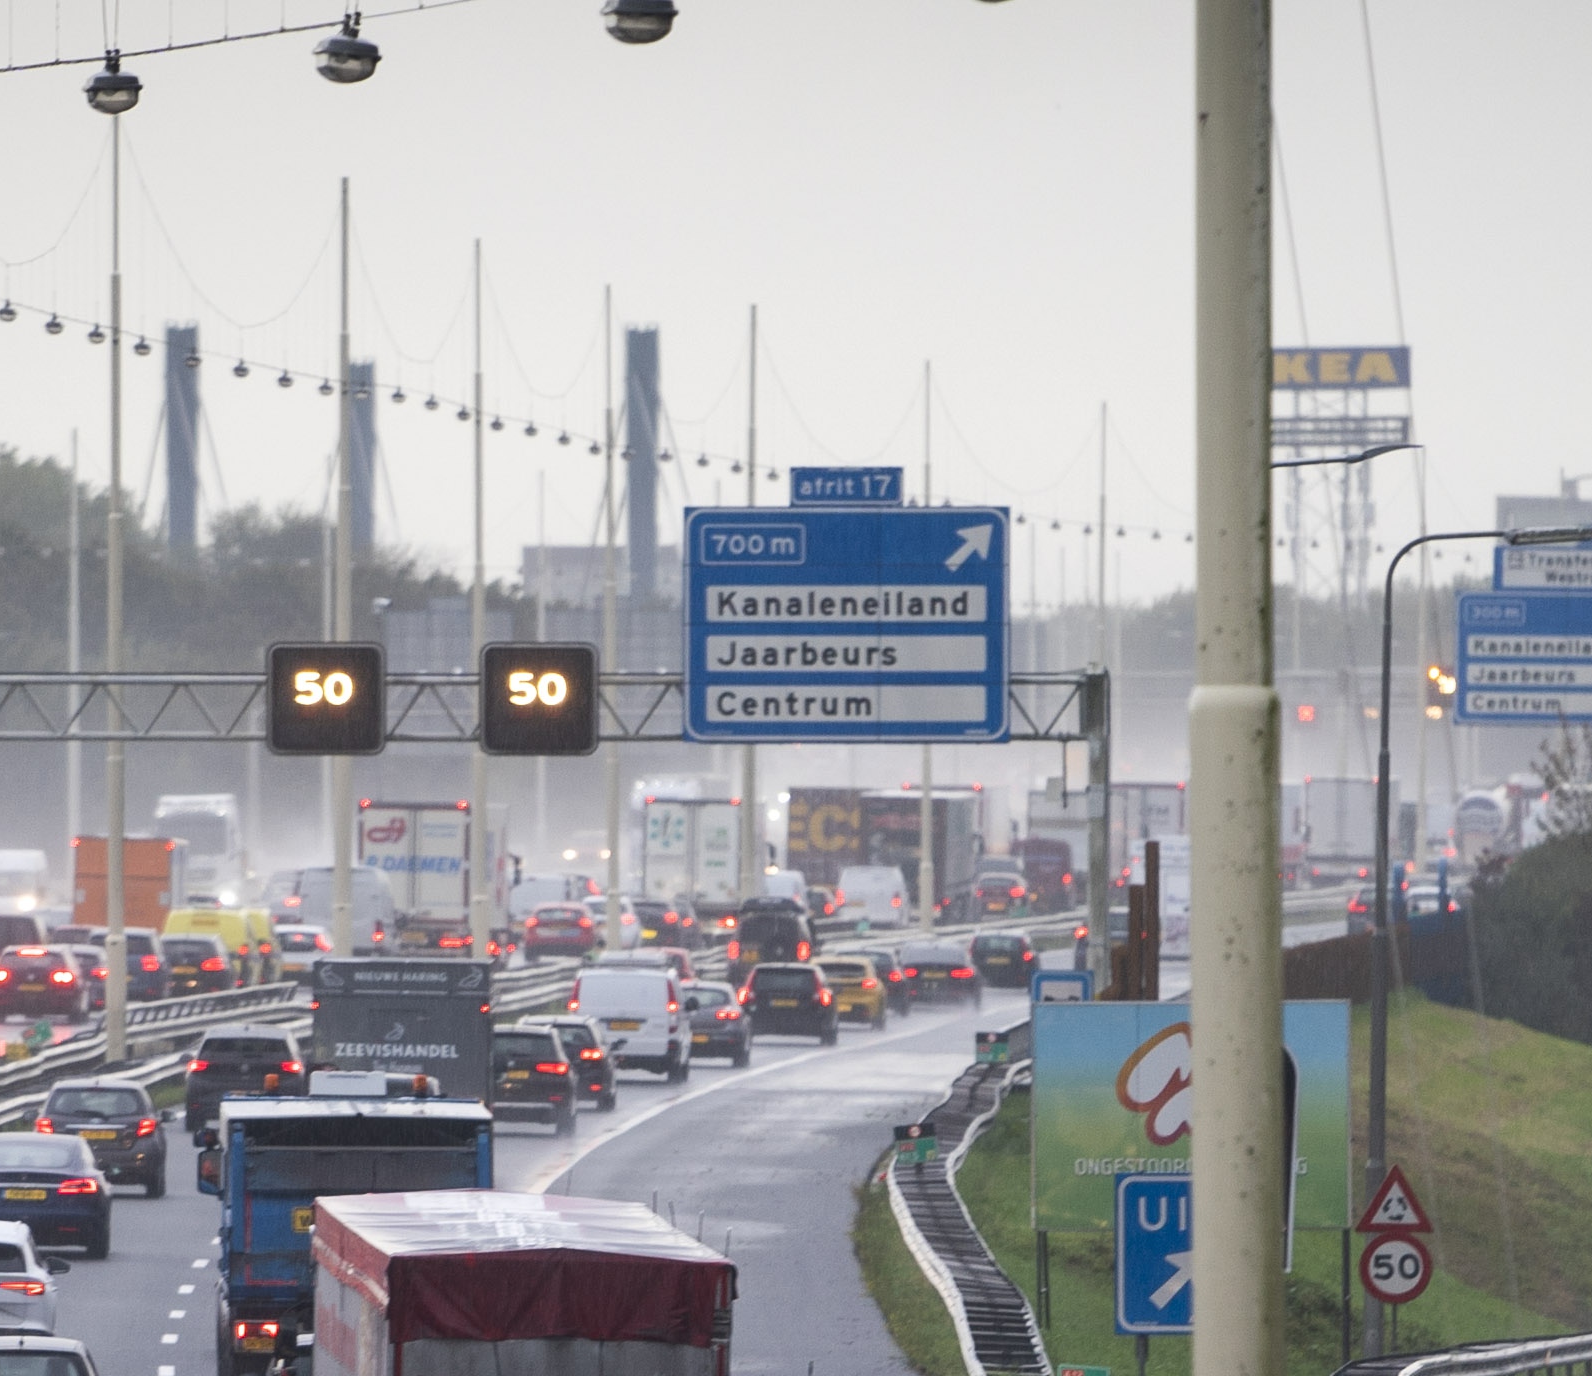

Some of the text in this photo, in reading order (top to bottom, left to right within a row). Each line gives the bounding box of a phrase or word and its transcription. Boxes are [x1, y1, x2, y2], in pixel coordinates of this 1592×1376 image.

[1273, 353, 1398, 383] KEA
[800, 474, 892, 497] afrit 17
[711, 534, 795, 555] 700 m
[716, 591, 969, 617] Kanaleneiland
[716, 641, 898, 666] Jaarbeurs
[294, 671, 353, 706] 50
[1472, 668, 1576, 683] Jaarbeurs
[508, 672, 567, 706] 50
[716, 691, 873, 717] Centrum
[1471, 695, 1562, 711] Centrum
[335, 1042, 460, 1059] ZEEVISHANDEL
[1137, 1196, 1187, 1232] UI
[1372, 1253, 1420, 1281] 50
